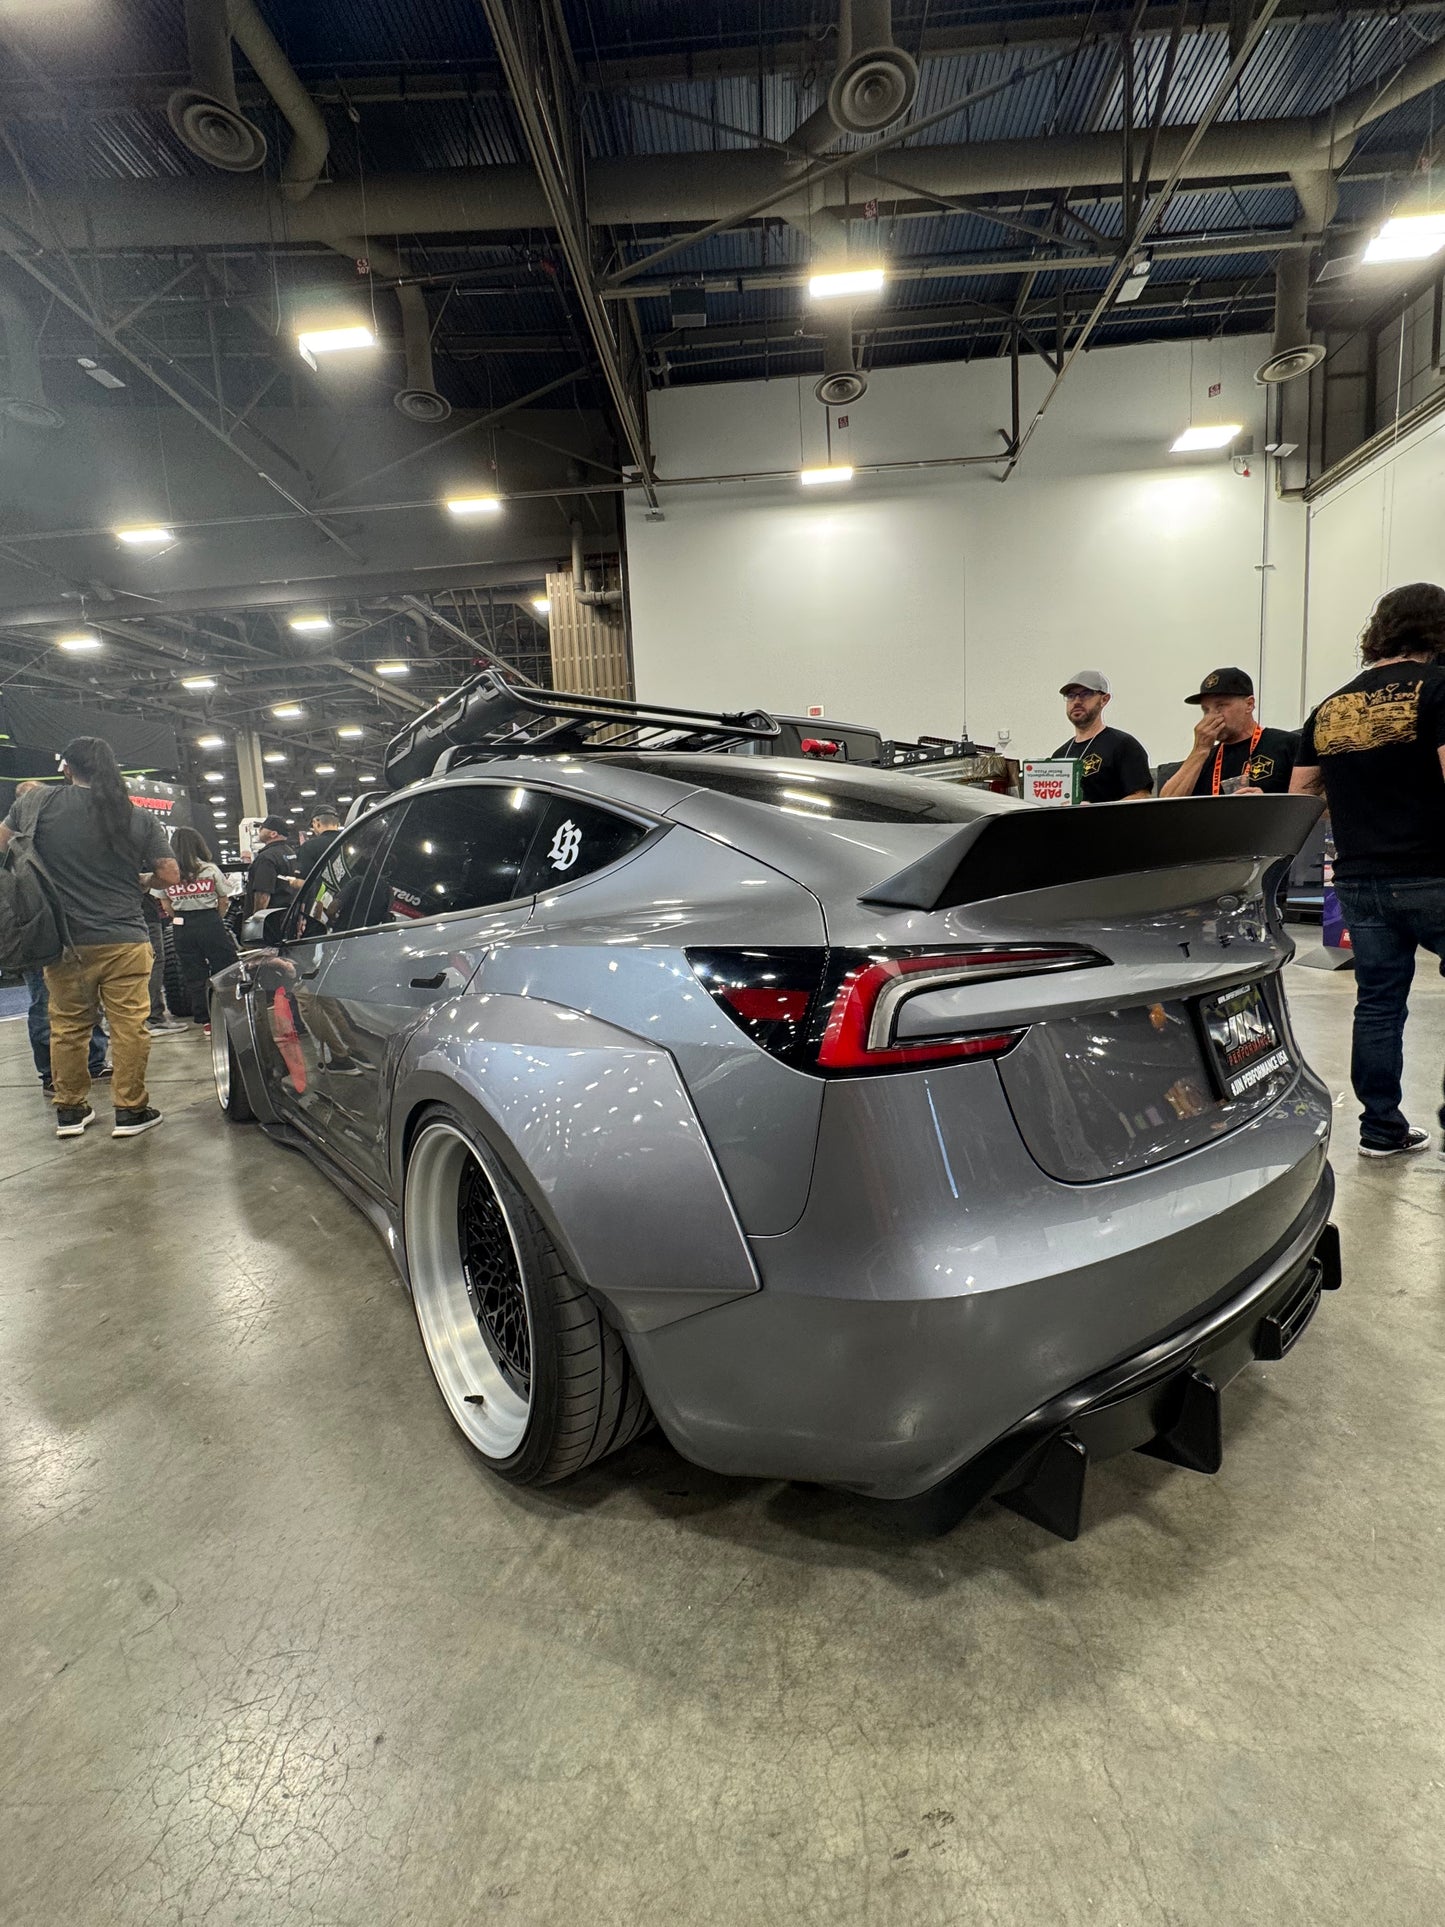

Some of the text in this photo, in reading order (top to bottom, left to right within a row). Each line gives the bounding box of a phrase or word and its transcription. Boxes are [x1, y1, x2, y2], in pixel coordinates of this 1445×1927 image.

[1033, 789, 1062, 800] PAPA
[168, 881, 212, 895] SHOW
[1241, 1055, 1280, 1089] PERFORMANCE
[1275, 1049, 1289, 1066] USA
